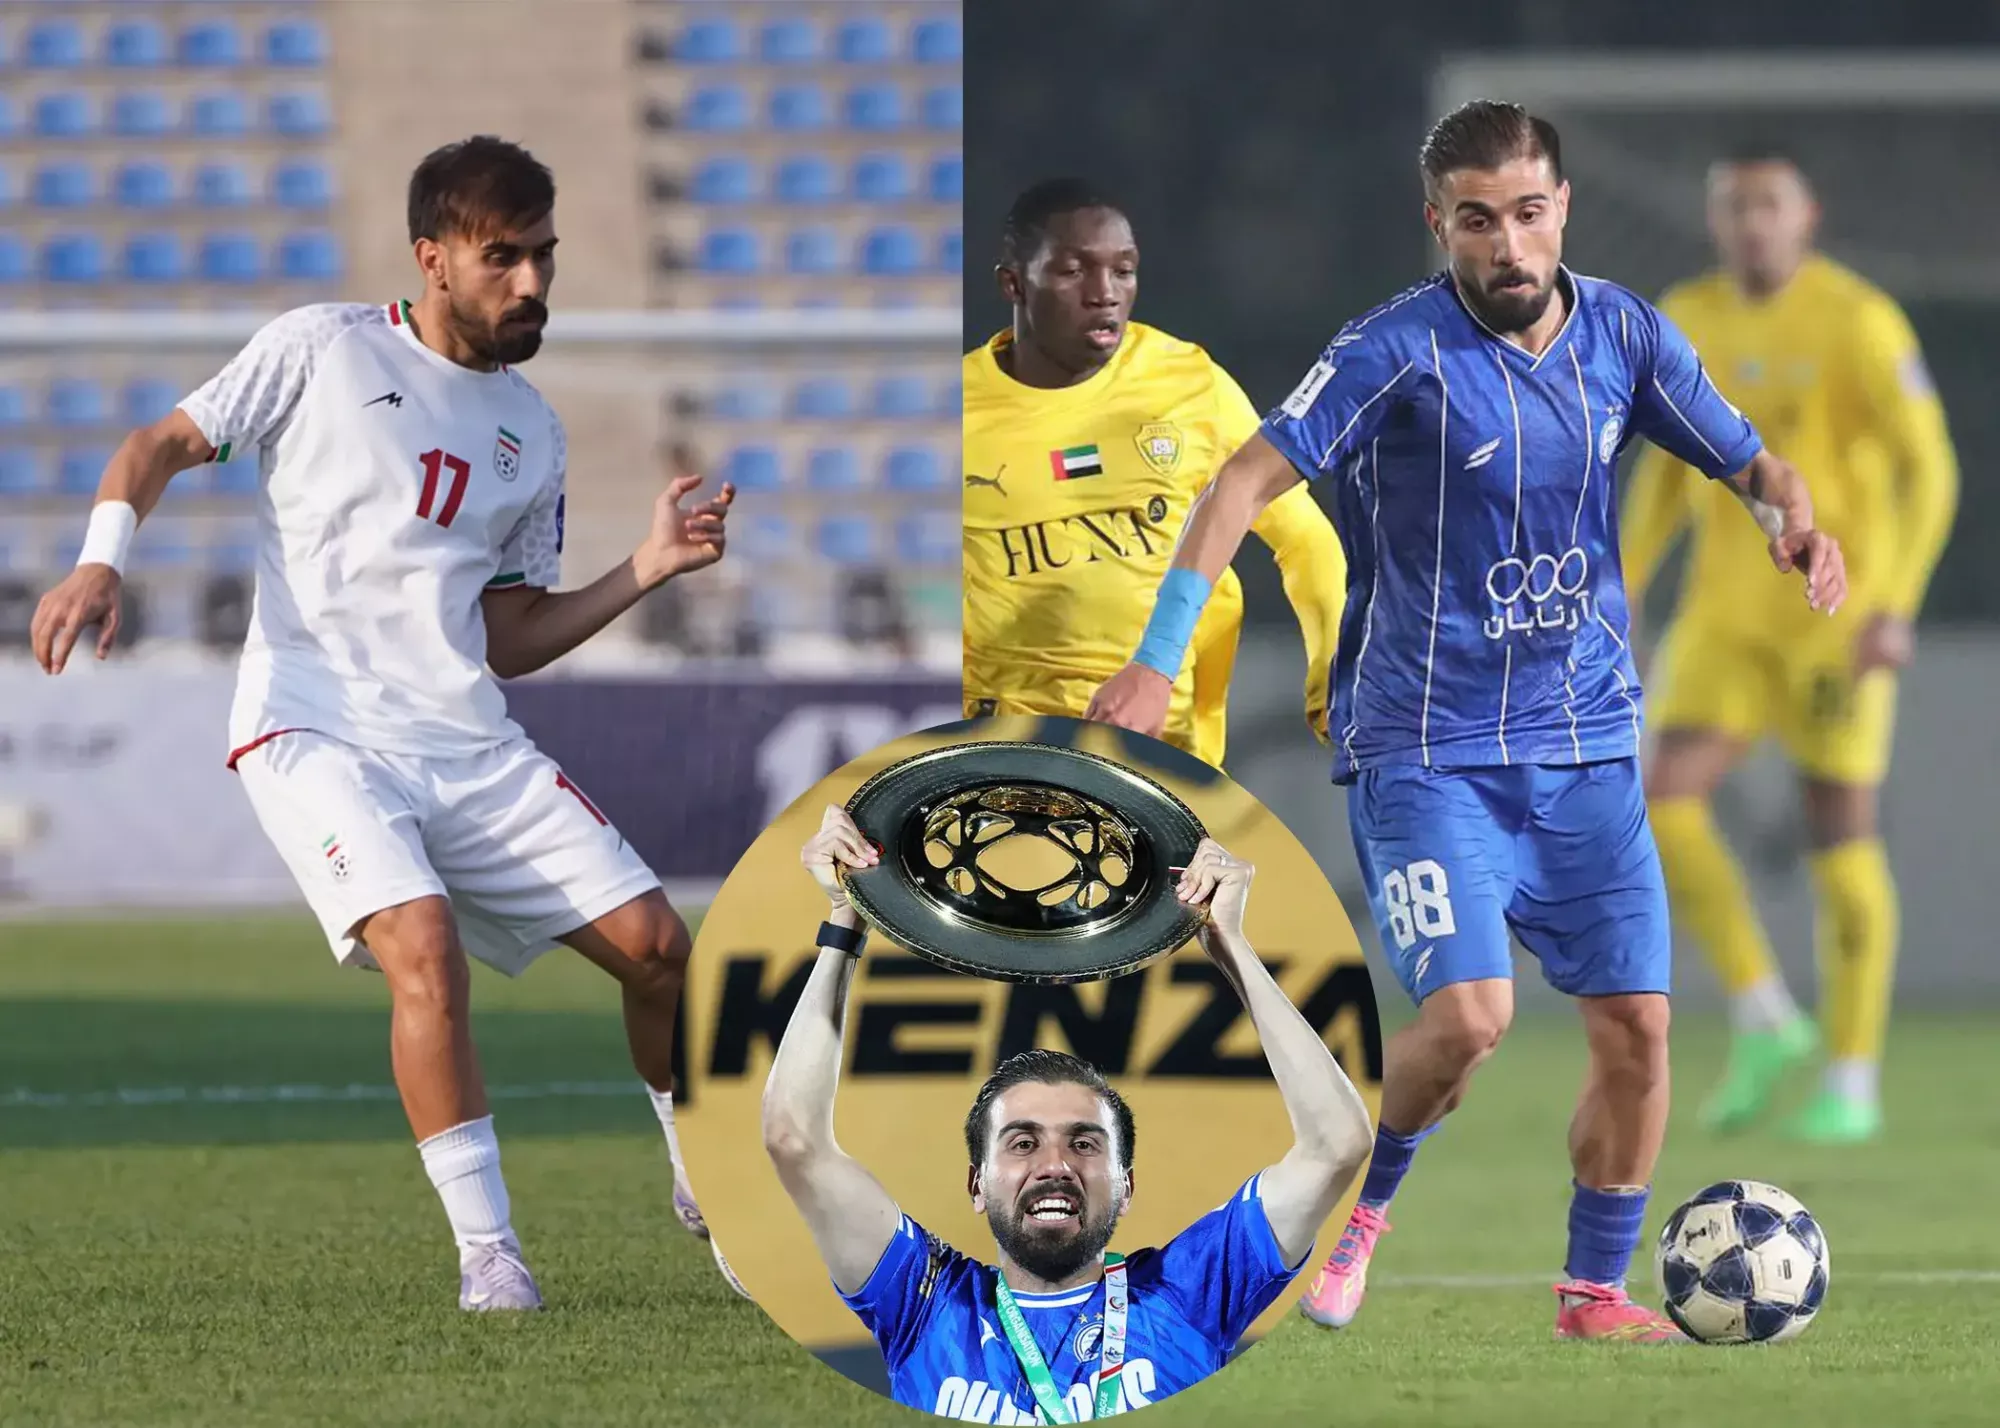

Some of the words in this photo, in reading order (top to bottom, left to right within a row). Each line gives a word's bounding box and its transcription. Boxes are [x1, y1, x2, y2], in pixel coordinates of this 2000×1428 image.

[416, 448, 471, 529] 17
[1484, 590, 1589, 639] آرتابان
[1383, 859, 1456, 950] 88
[1005, 1307, 1041, 1368] ORGANISATION
